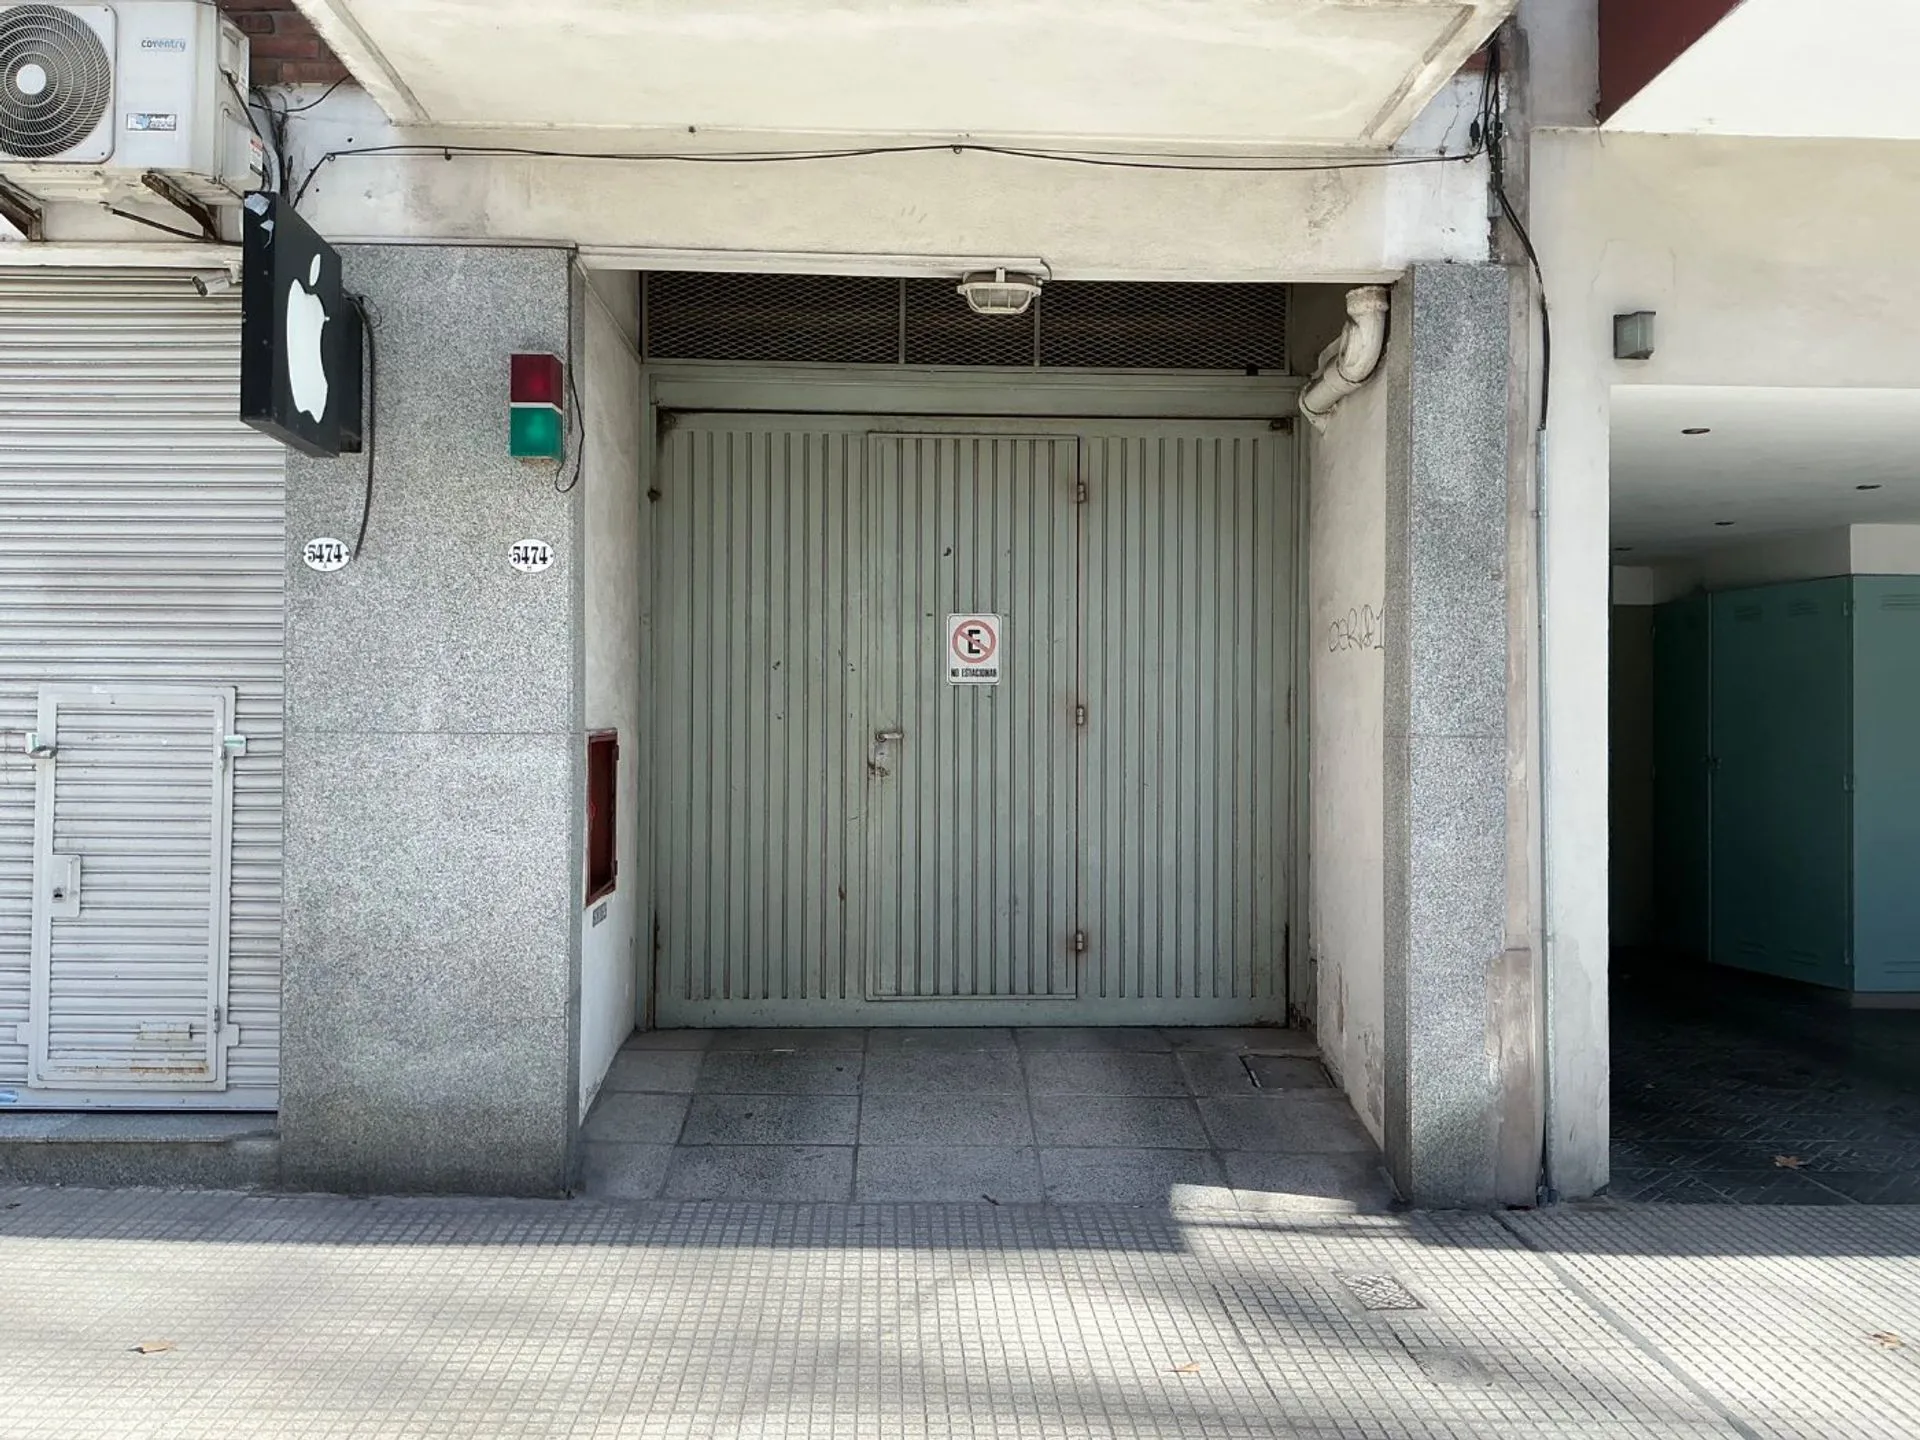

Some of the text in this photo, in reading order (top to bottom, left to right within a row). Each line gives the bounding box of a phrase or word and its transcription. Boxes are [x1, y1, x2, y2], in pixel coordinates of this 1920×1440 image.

[141, 38, 186, 52] coventry
[307, 543, 343, 563] 5474
[512, 545, 548, 565] 5474
[967, 629, 981, 654] E
[951, 667, 997, 677] NO ESTACIONAR
